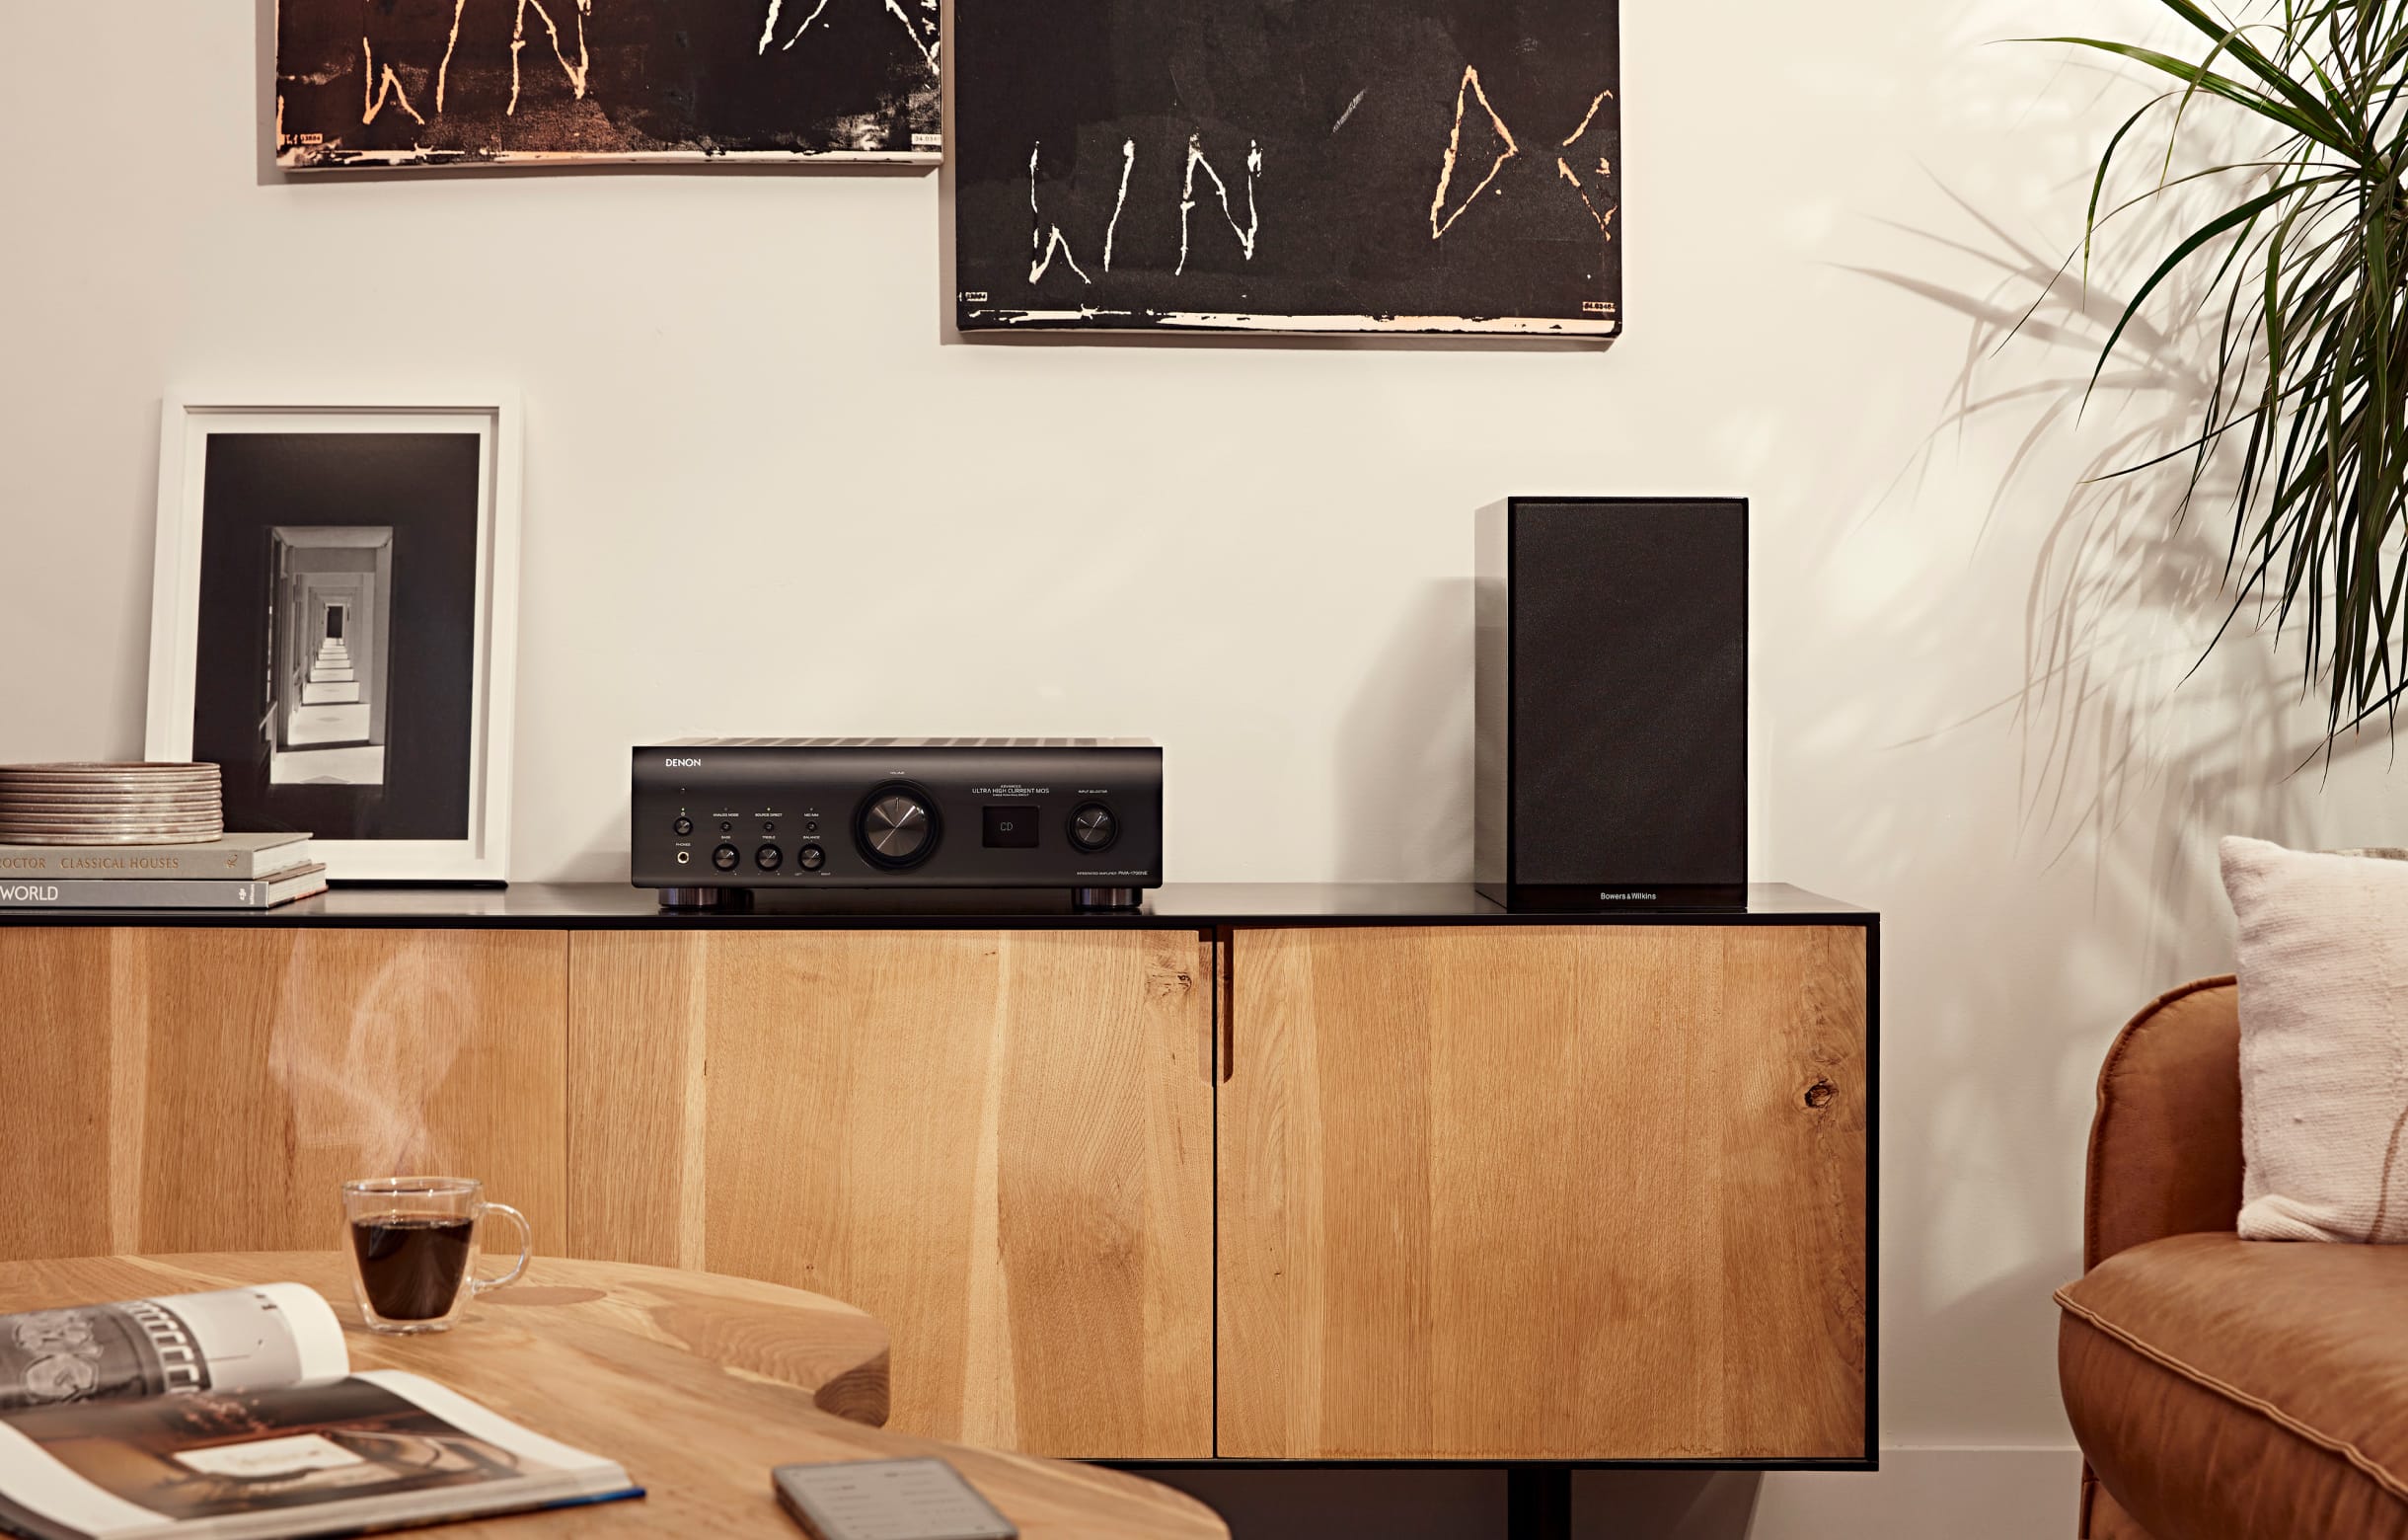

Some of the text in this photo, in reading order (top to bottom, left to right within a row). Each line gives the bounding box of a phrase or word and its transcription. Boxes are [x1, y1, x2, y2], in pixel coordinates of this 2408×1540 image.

[665, 758, 702, 767] DENON
[1000, 821, 1014, 831] CD
[60, 857, 125, 869] CLASSICAL
[129, 857, 179, 869] HOUSES
[0, 886, 58, 900] WORLD
